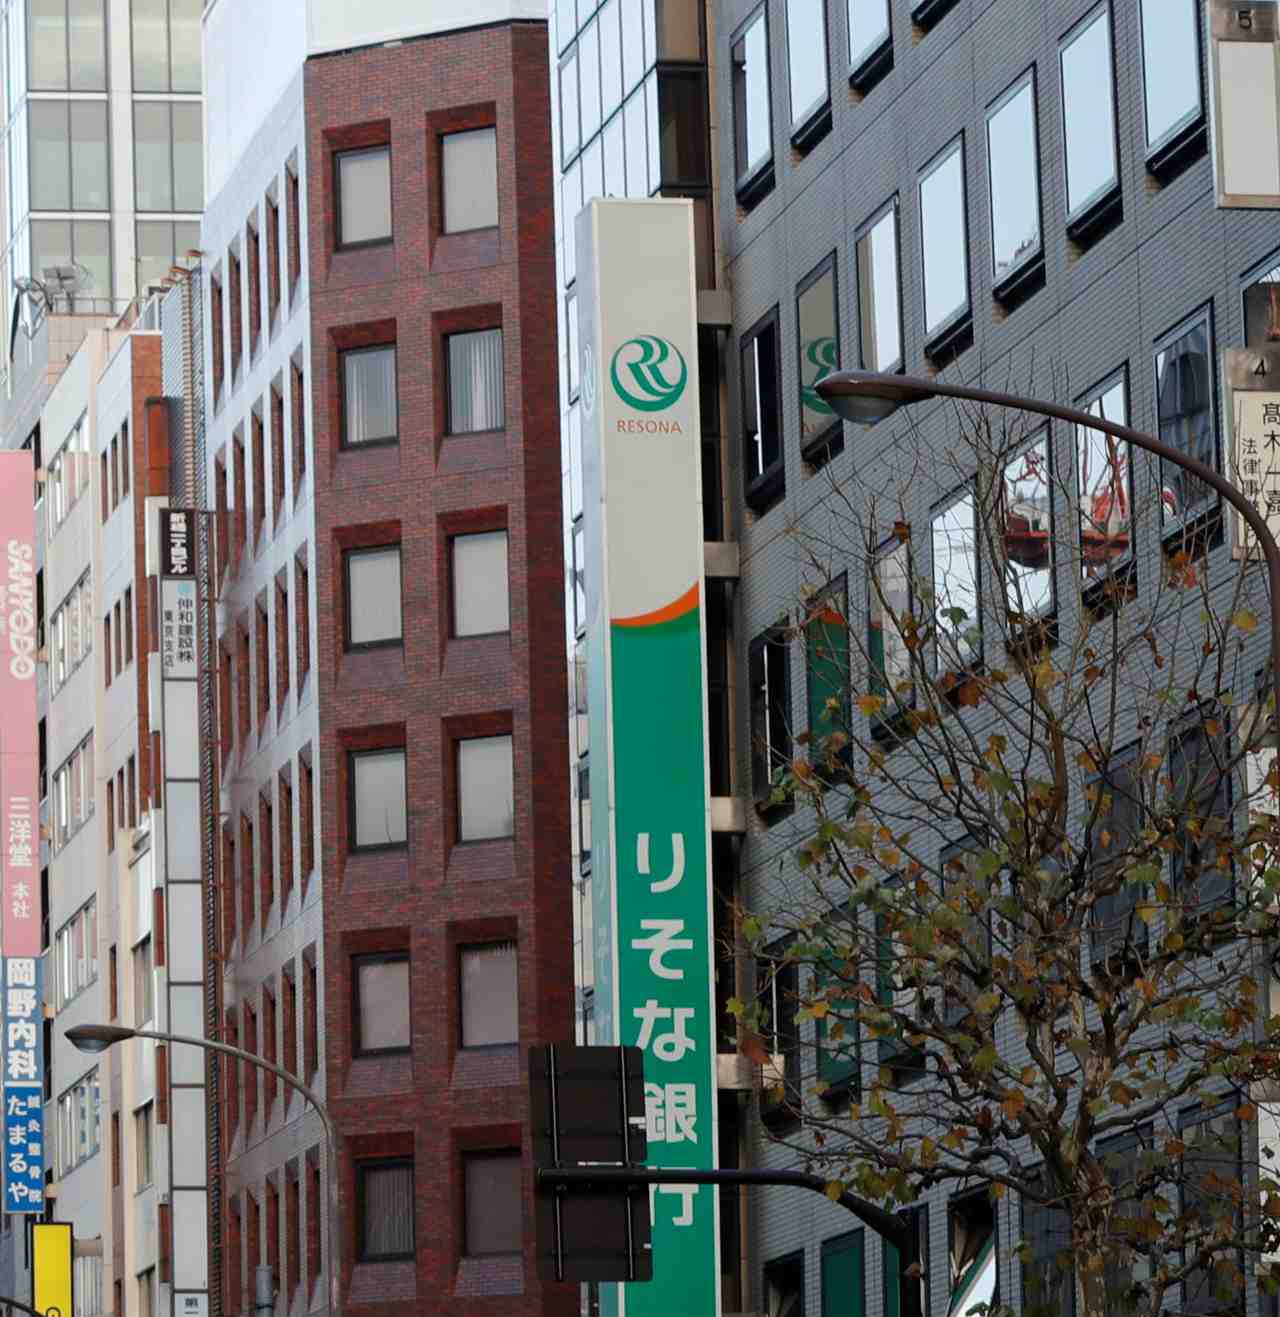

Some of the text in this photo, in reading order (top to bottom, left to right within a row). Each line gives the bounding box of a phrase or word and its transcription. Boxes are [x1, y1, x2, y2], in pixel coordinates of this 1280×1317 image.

[1238, 10, 1252, 30] 5
[1254, 358, 1268, 378] 4
[616, 419, 682, 433] RESONA
[6, 957, 38, 1080] 岡野内科
[7, 1095, 29, 1205] たまるや
